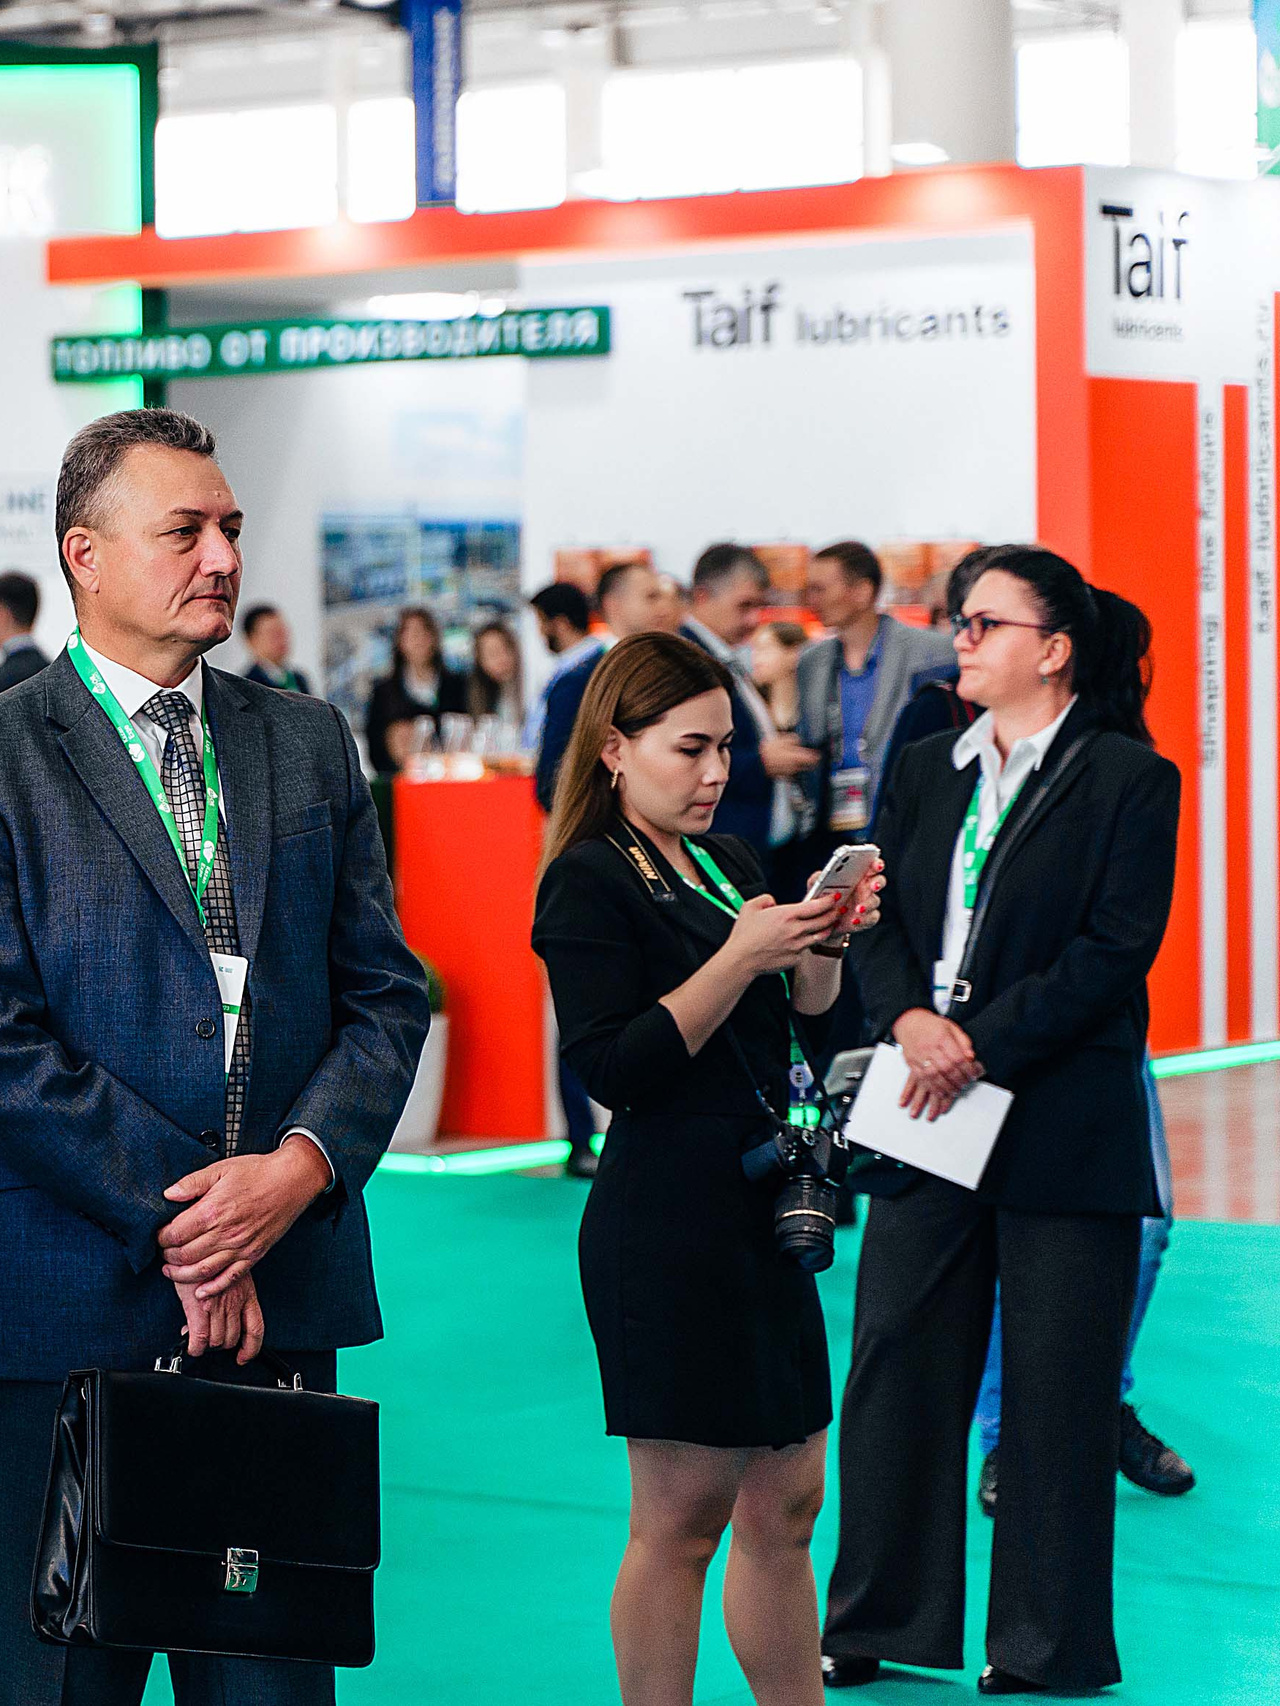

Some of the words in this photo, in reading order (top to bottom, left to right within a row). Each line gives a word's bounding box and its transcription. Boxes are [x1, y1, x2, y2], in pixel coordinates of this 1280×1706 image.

[1101, 204, 1189, 299] Taif
[55, 332, 212, 376] ТОПЛИВО
[220, 329, 267, 368] ОТ
[278, 308, 599, 364] ПРОИЗВОДИТЕЛЯ
[682, 284, 780, 348] Taif
[796, 303, 1011, 343] lubricants
[628, 846, 659, 880] Nikon
